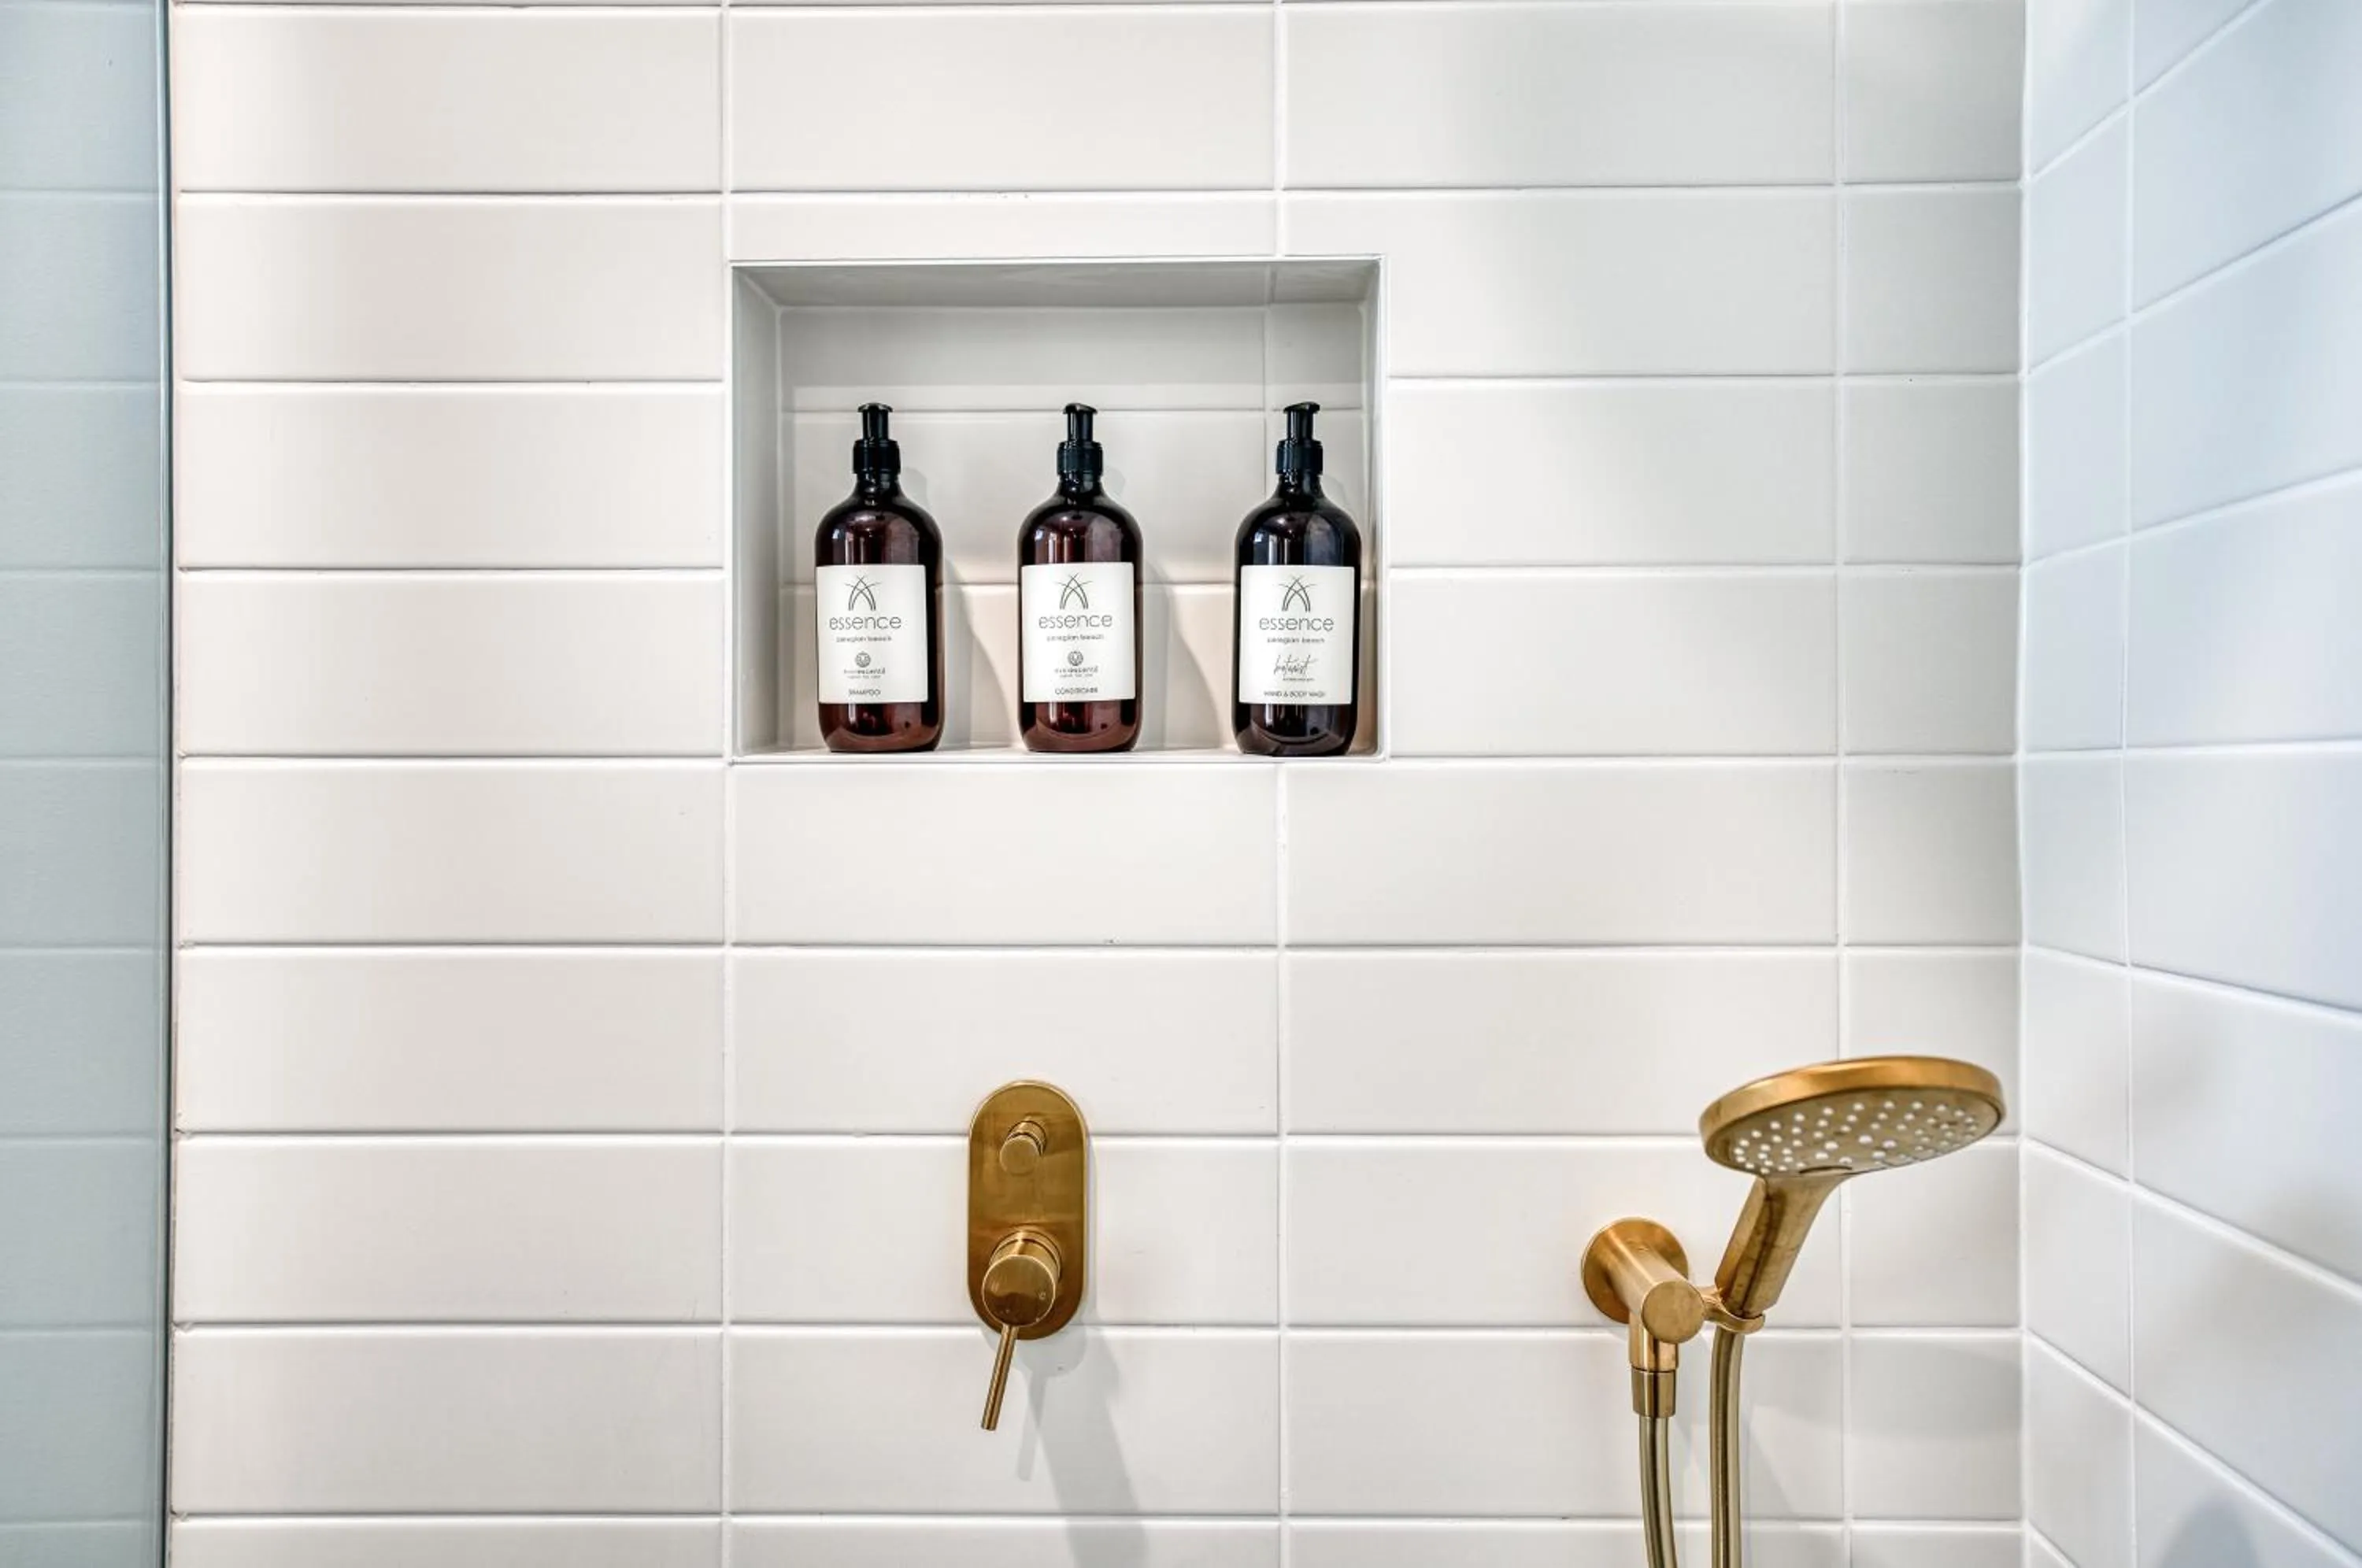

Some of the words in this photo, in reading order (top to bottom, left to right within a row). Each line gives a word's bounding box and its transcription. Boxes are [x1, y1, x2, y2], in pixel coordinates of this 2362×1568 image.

[829, 616, 901, 630] essence
[1038, 615, 1113, 629] essence
[1259, 617, 1335, 631] essence
